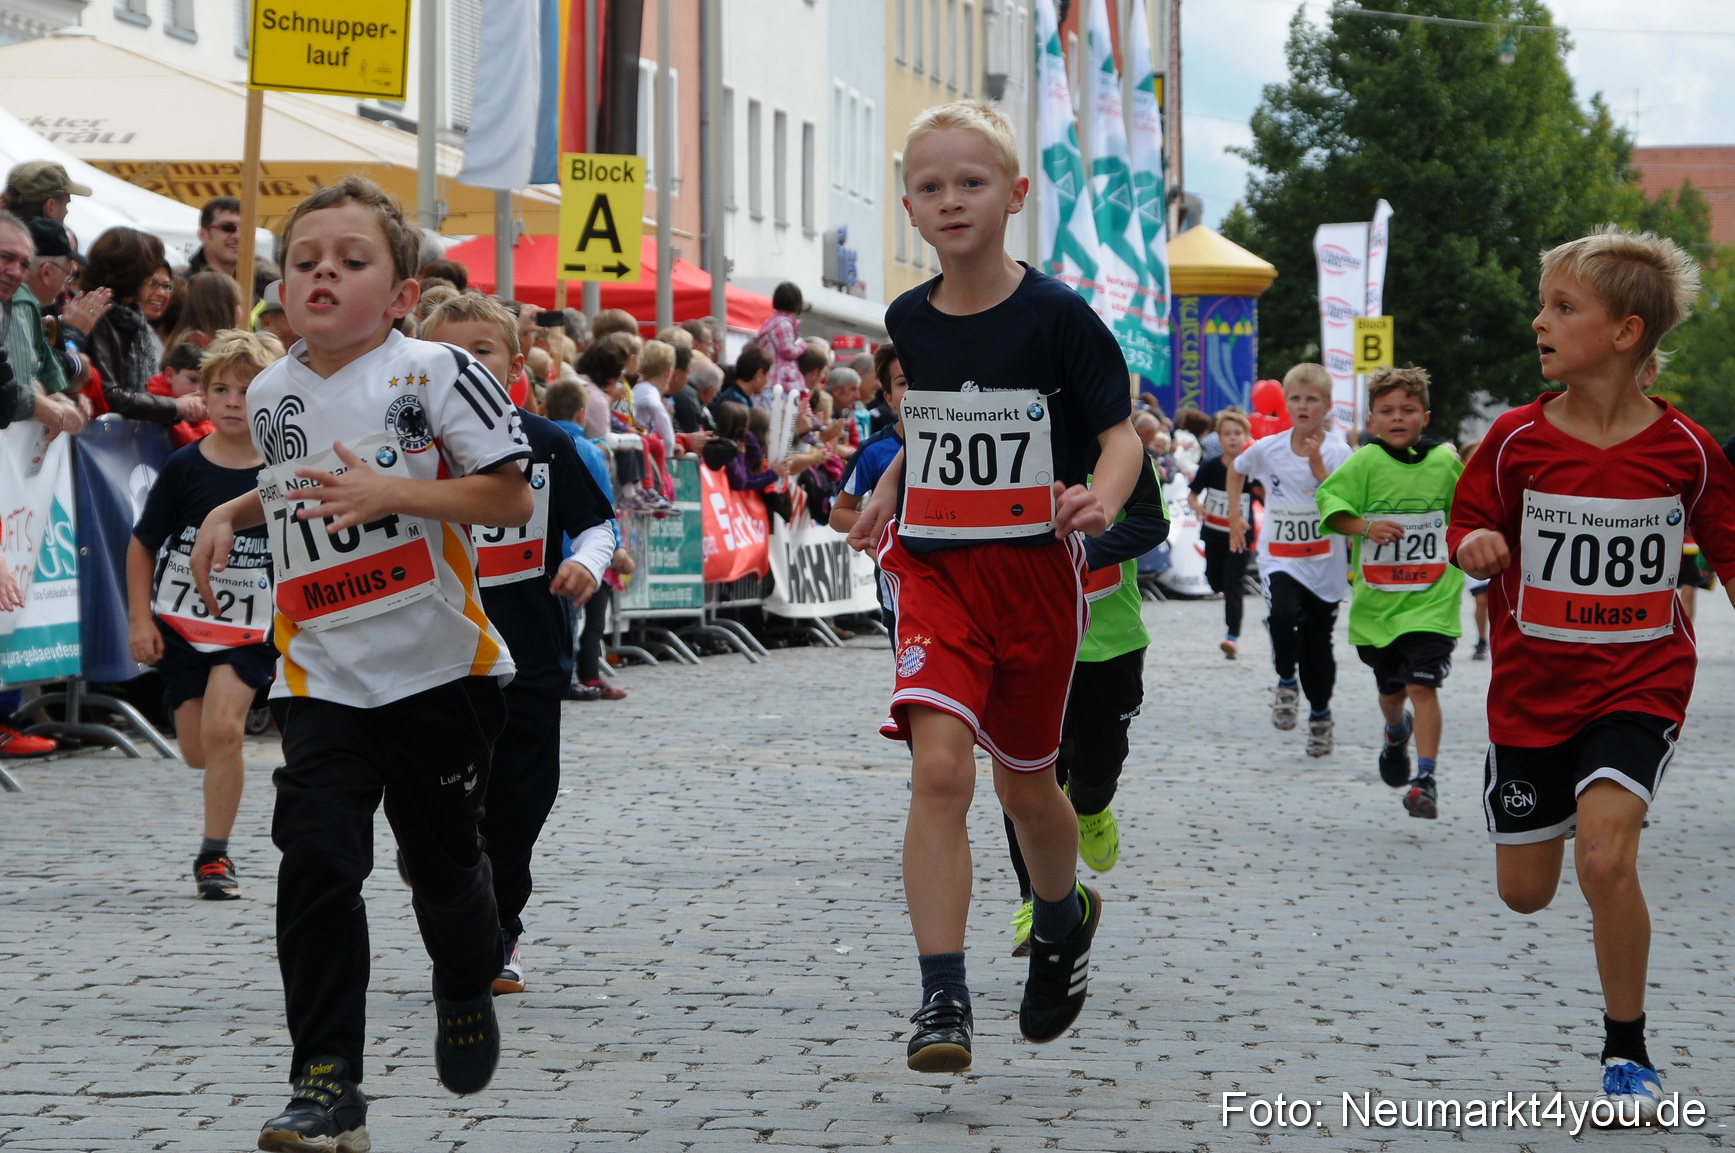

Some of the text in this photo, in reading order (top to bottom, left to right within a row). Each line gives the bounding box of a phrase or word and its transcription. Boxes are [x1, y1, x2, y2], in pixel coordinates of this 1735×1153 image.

[262, 8, 397, 41] Schnupper-
[306, 43, 350, 67] lauf
[19, 116, 108, 128] kter
[571, 158, 634, 182] Block
[575, 193, 622, 253] A
[1363, 334, 1380, 361] B
[904, 406, 1020, 421] PARTL Neumarkt
[919, 432, 1030, 486] 7307
[925, 499, 956, 520] Luis
[1527, 505, 1660, 529] PARTL Neumarkt
[1538, 529, 1666, 588] 7089
[1392, 569, 1419, 581] Max
[302, 569, 387, 611] Marius
[171, 580, 254, 625] 7321
[1565, 600, 1633, 625] Lukas
[440, 773, 462, 786] Luis
[1503, 792, 1534, 808] FCN
